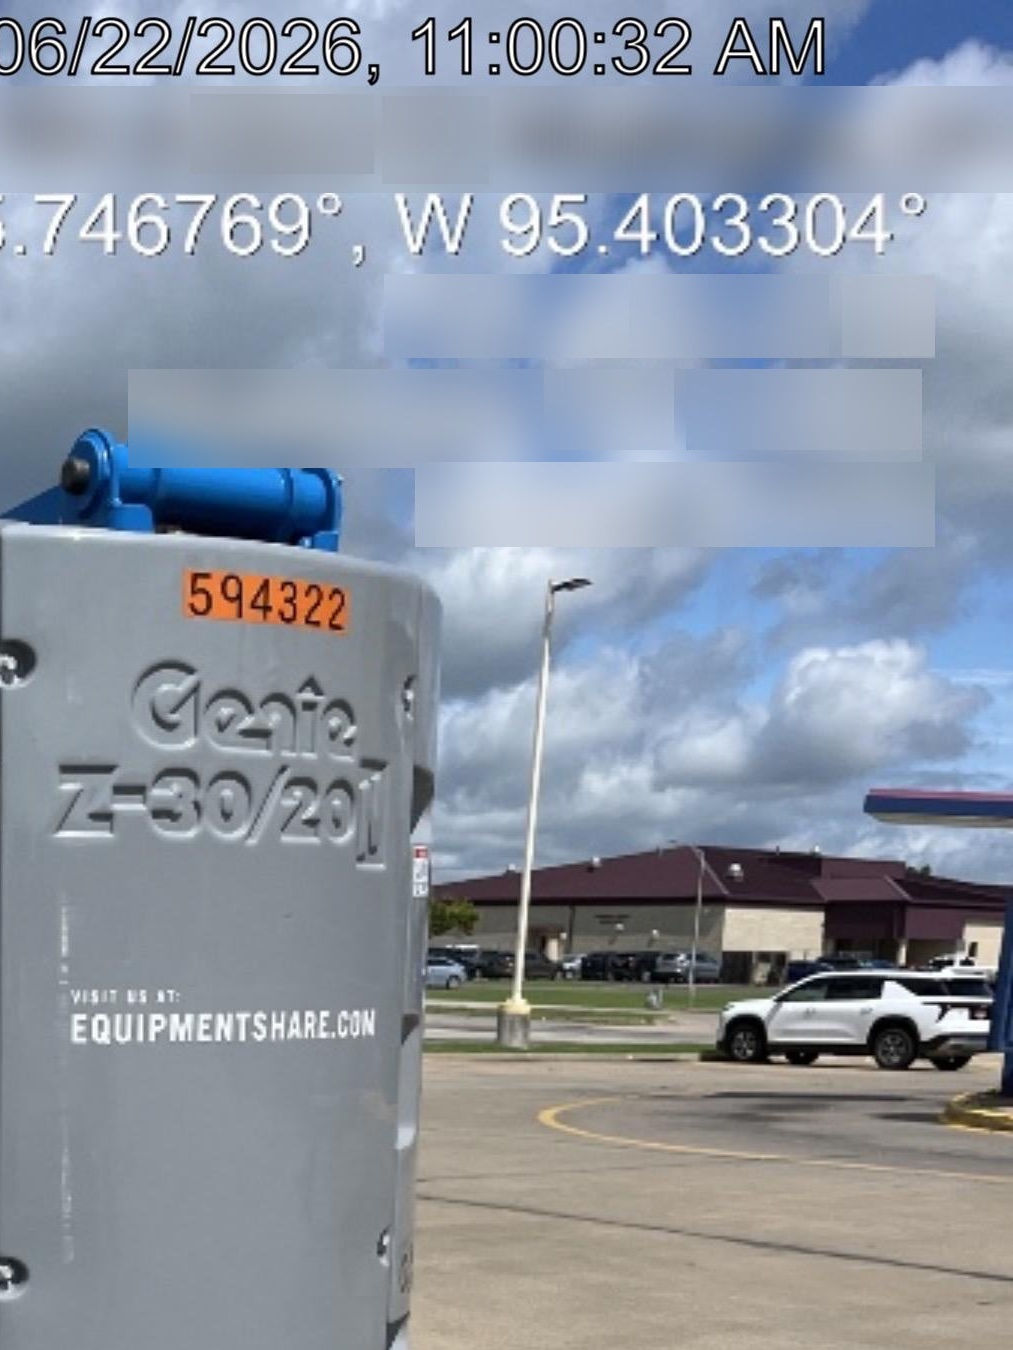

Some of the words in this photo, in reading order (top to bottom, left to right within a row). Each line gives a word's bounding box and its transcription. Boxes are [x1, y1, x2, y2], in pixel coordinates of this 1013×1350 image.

[188, 572, 346, 631] 594322
[132, 659, 358, 763] Genie
[70, 989, 118, 1005] VISIT
[127, 989, 148, 1005] US
